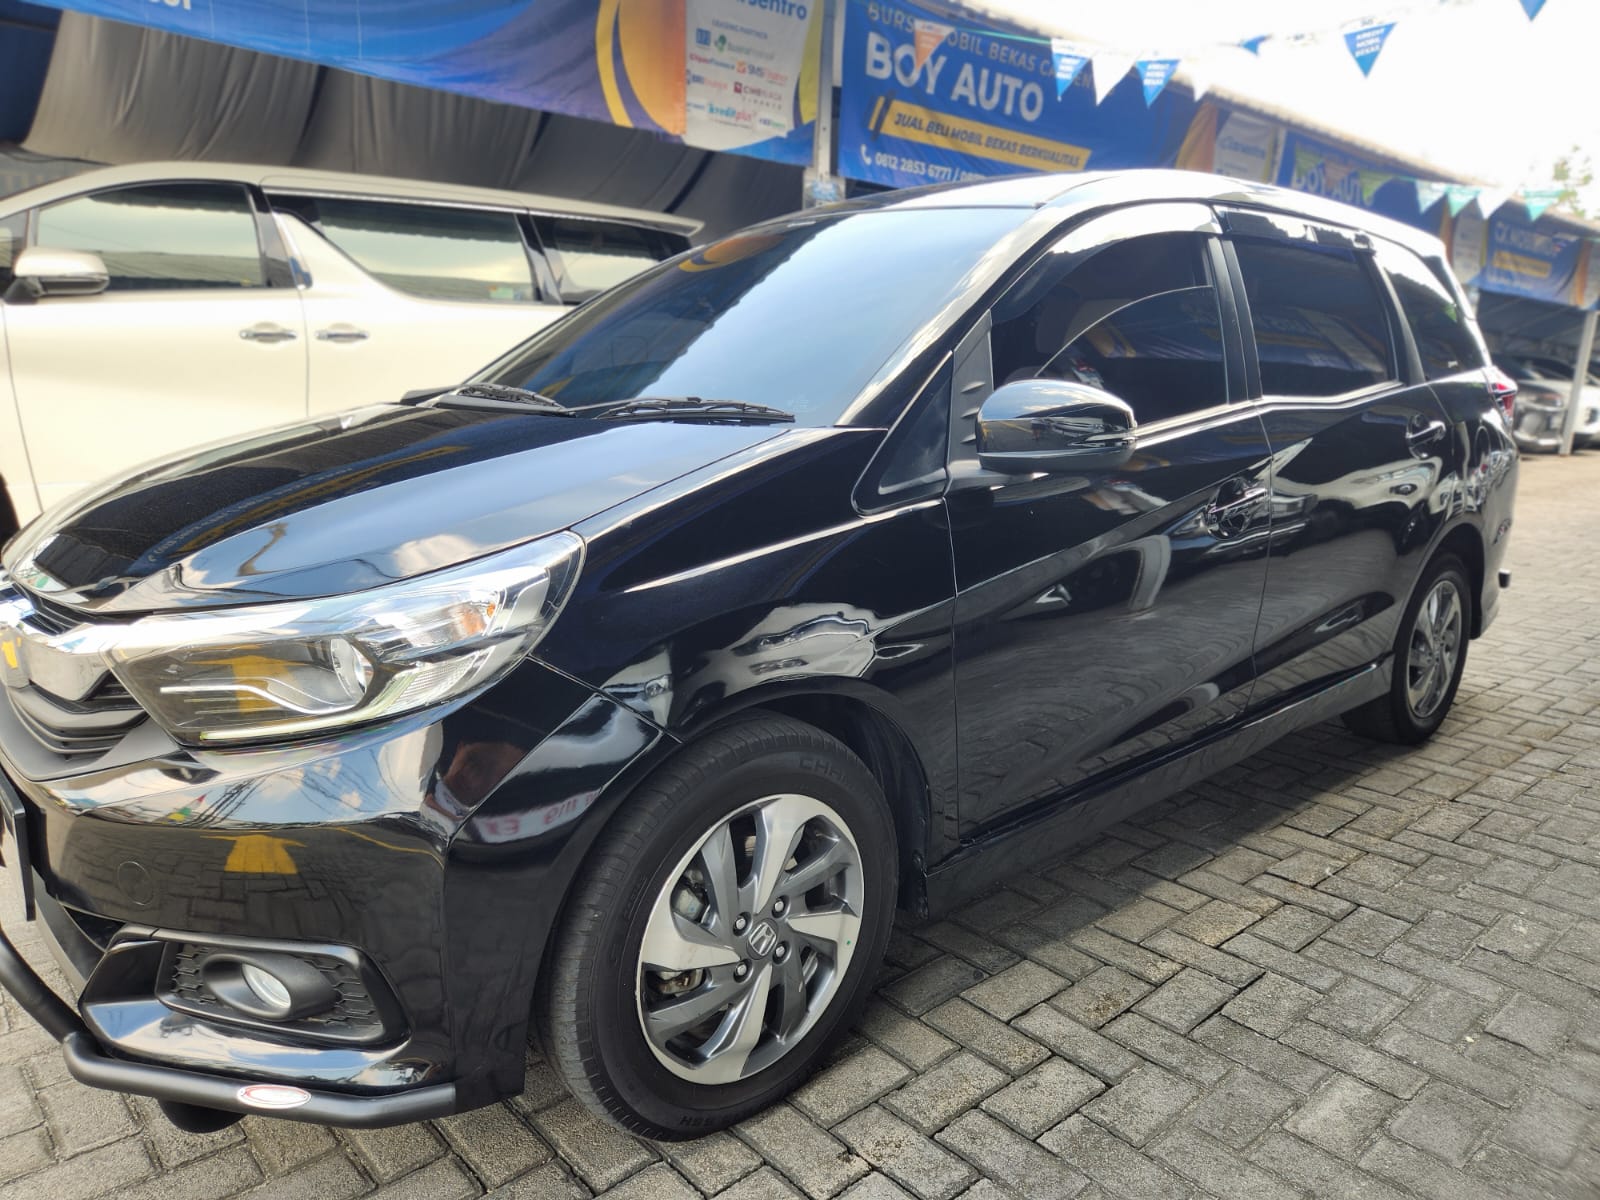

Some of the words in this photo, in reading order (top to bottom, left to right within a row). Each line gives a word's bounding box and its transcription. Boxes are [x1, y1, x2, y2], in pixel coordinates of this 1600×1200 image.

[737, 0, 807, 20] sentro
[868, 2, 916, 33] BURS
[947, 31, 984, 56] OBIL
[989, 42, 1035, 71] BEKAS
[866, 32, 947, 94] BOY
[951, 63, 1044, 122] AUTO
[894, 112, 923, 131] JUAL
[926, 120, 950, 137] BELI
[950, 127, 982, 146] MOBIL
